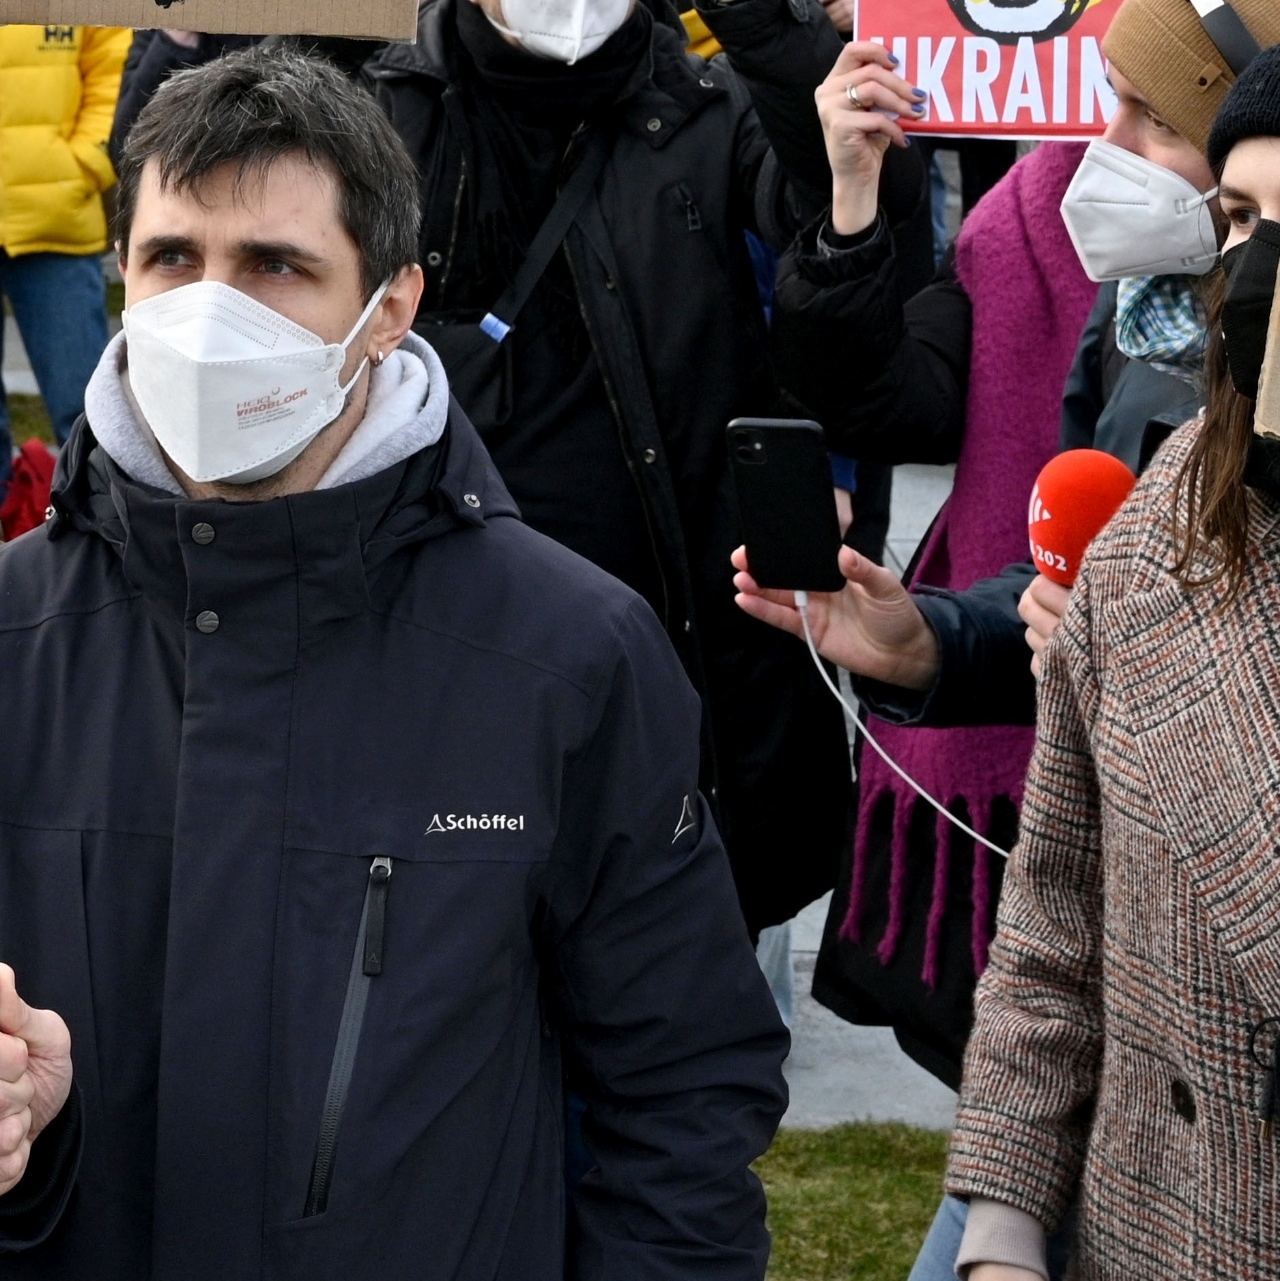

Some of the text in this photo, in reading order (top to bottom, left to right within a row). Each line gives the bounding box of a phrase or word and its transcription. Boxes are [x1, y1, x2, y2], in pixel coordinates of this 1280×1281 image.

[236, 387, 309, 417] VIROBLOCK
[1035, 544, 1067, 572] 202
[446, 814, 524, 830] Schöffel
